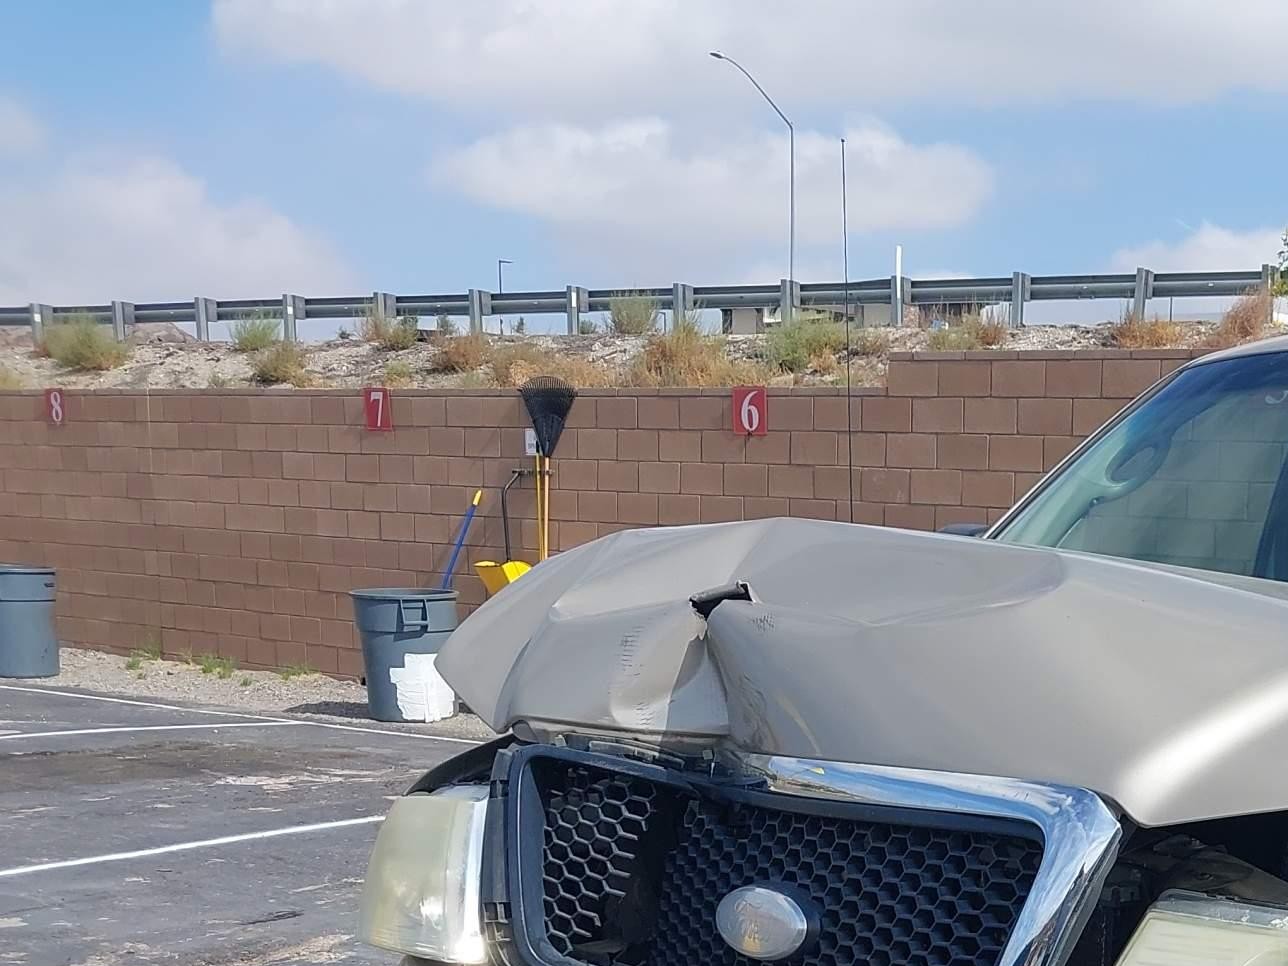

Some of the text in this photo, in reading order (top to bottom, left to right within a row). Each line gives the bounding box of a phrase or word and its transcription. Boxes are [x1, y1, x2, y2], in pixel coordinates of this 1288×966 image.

[50, 391, 63, 422] 8
[370, 391, 384, 427] 7
[741, 390, 759, 431] 6
